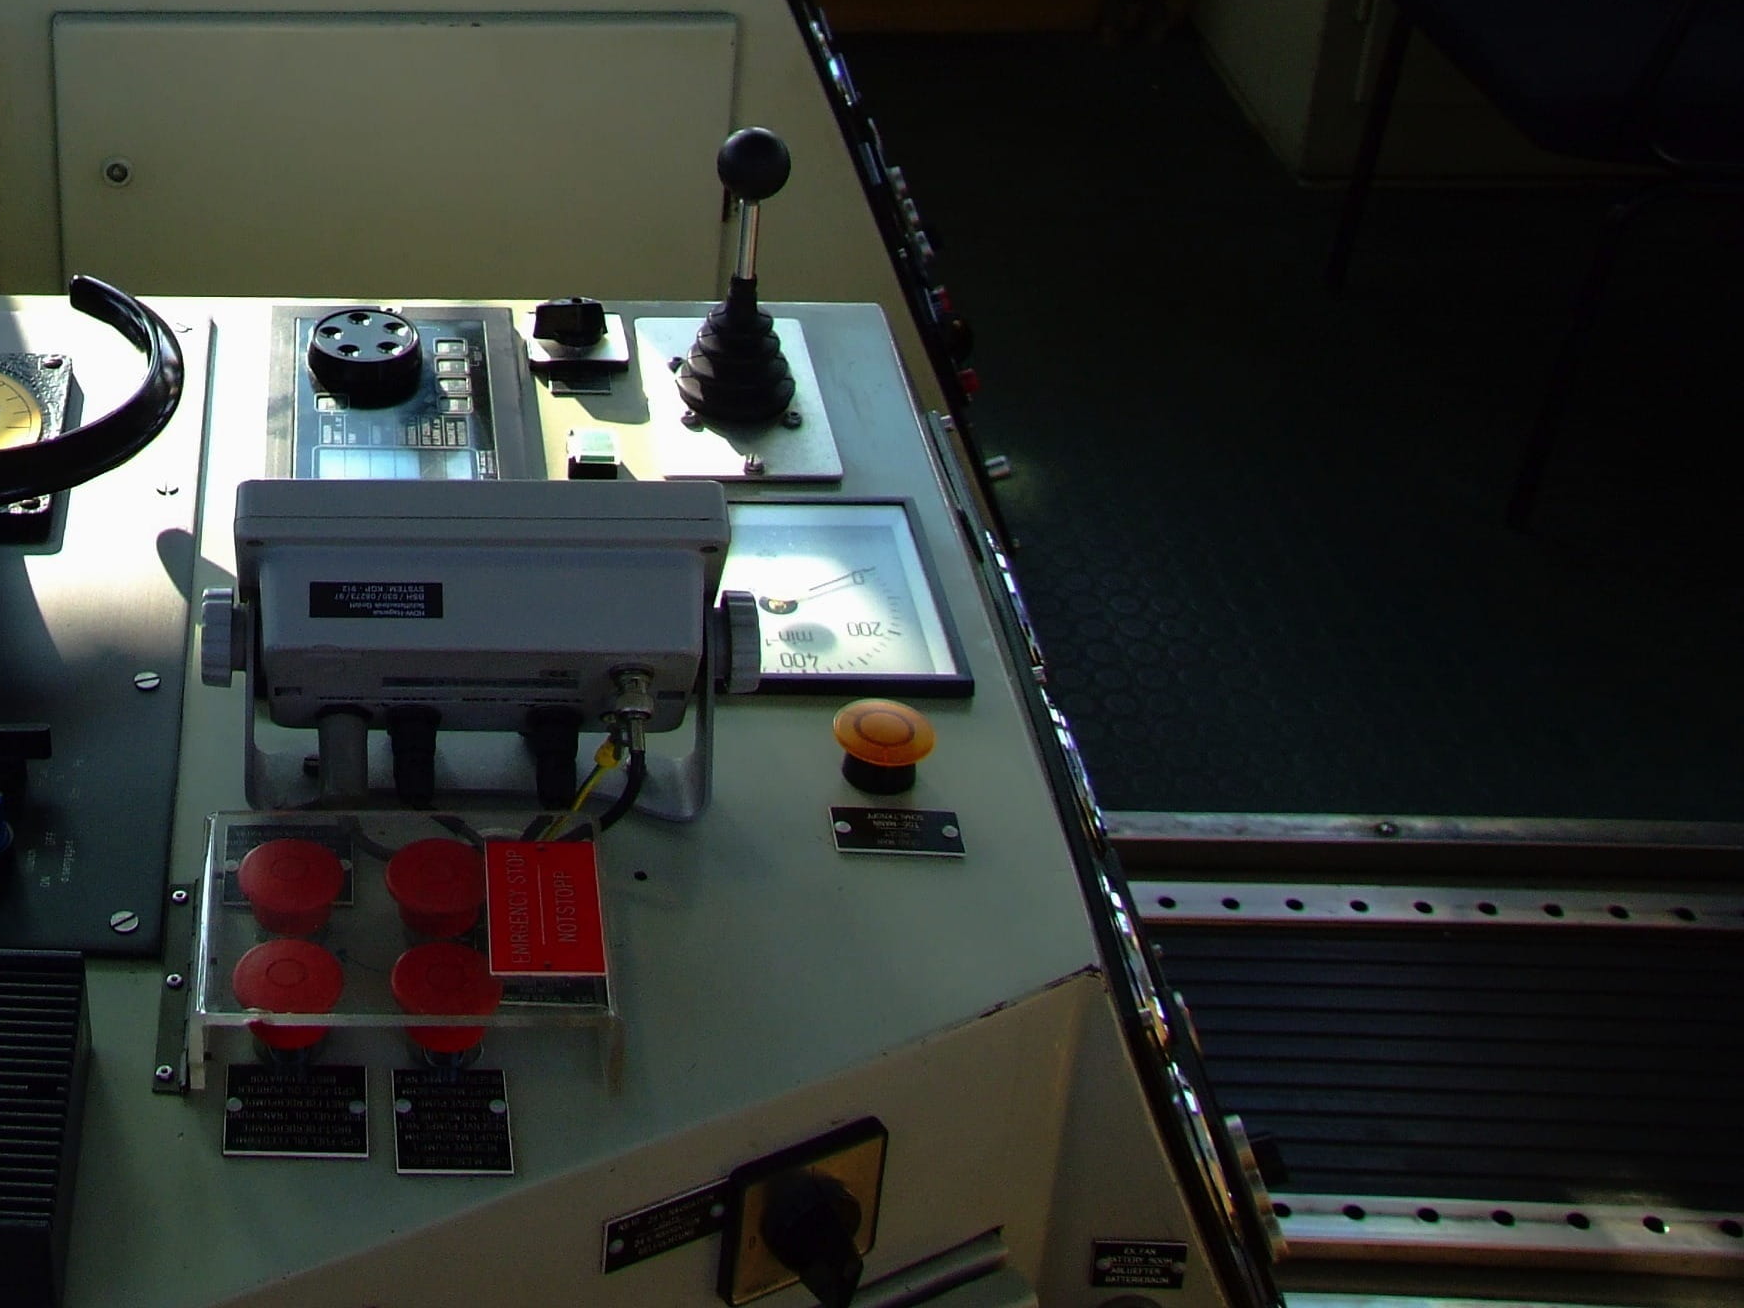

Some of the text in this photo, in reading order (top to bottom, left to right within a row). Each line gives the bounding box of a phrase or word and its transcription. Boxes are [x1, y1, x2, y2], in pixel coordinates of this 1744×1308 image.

[851, 570, 865, 586] 0
[846, 621, 883, 637] 200
[780, 652, 818, 668] 400
[504, 848, 531, 964] EMRGENCY STOP
[552, 870, 578, 943] NOTSTOPP
